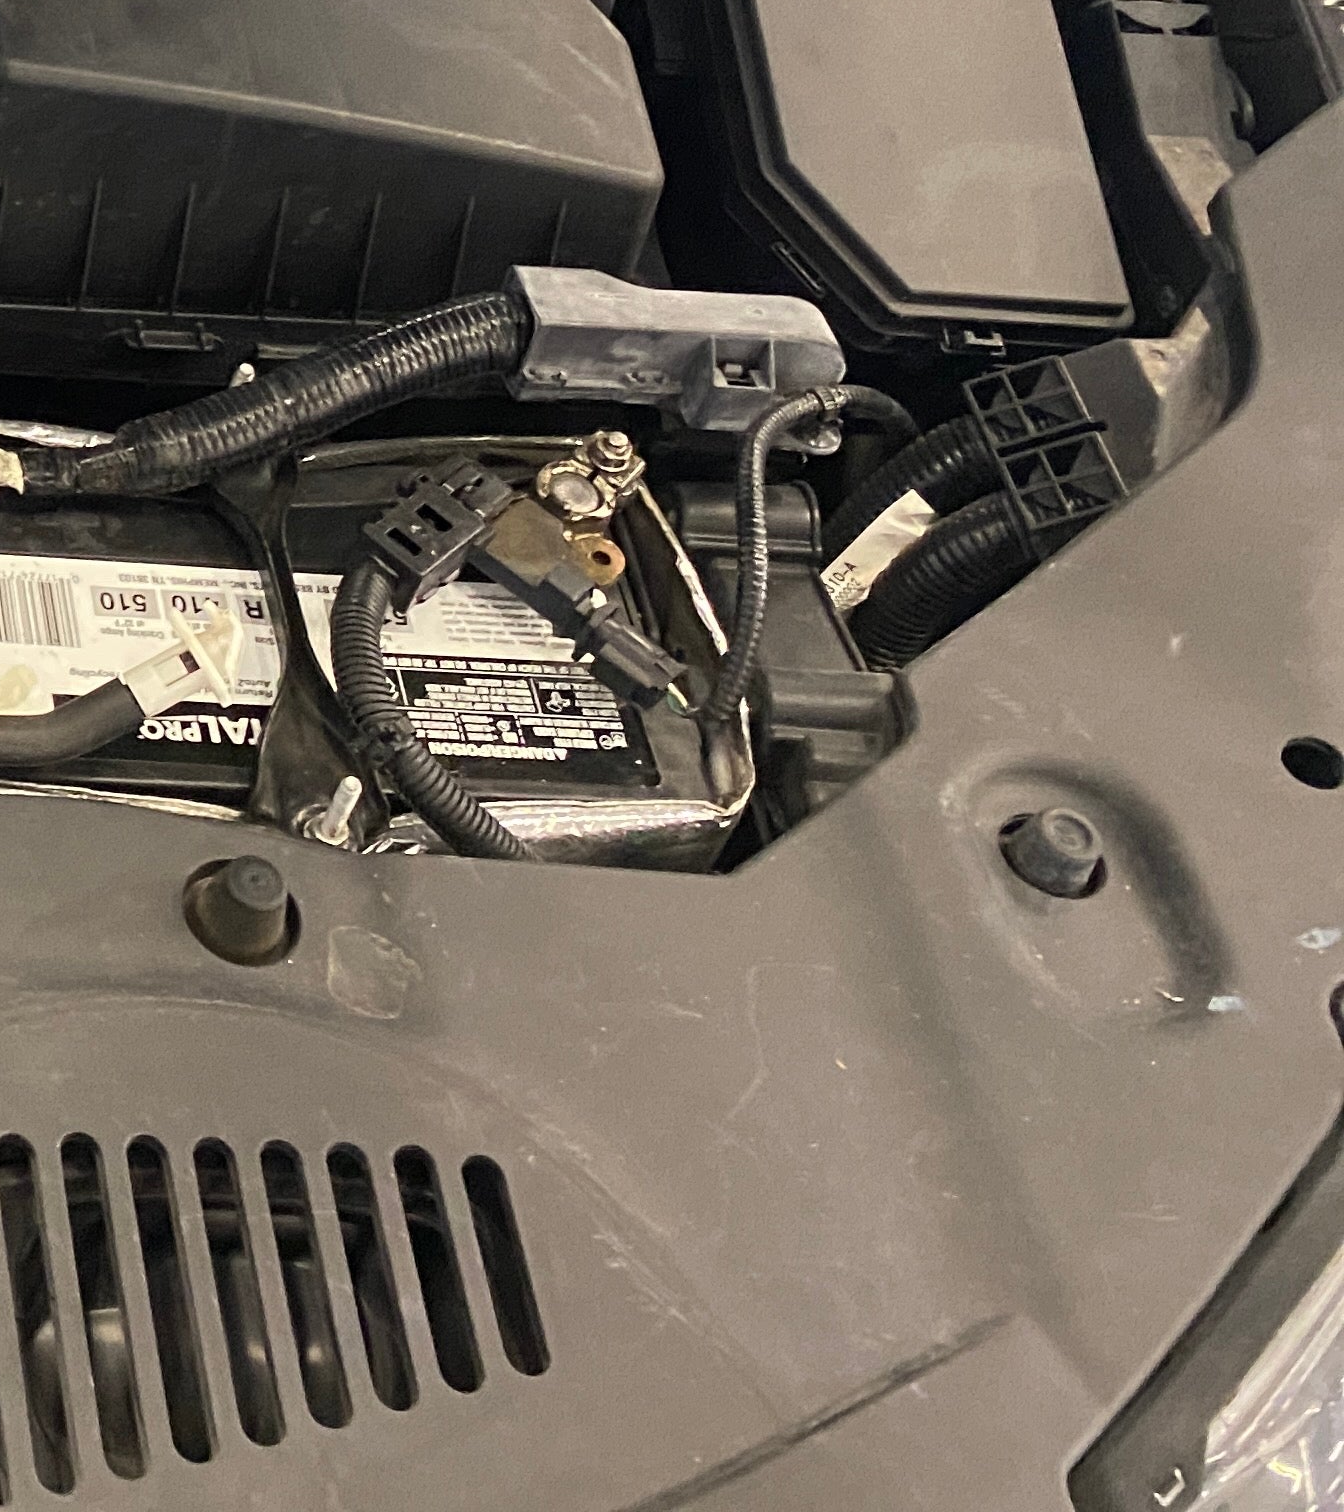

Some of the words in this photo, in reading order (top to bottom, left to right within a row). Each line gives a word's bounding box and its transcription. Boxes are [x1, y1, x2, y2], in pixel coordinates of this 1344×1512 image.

[100, 592, 148, 613] 510
[243, 599, 265, 620] R
[234, 689, 273, 698] Return
